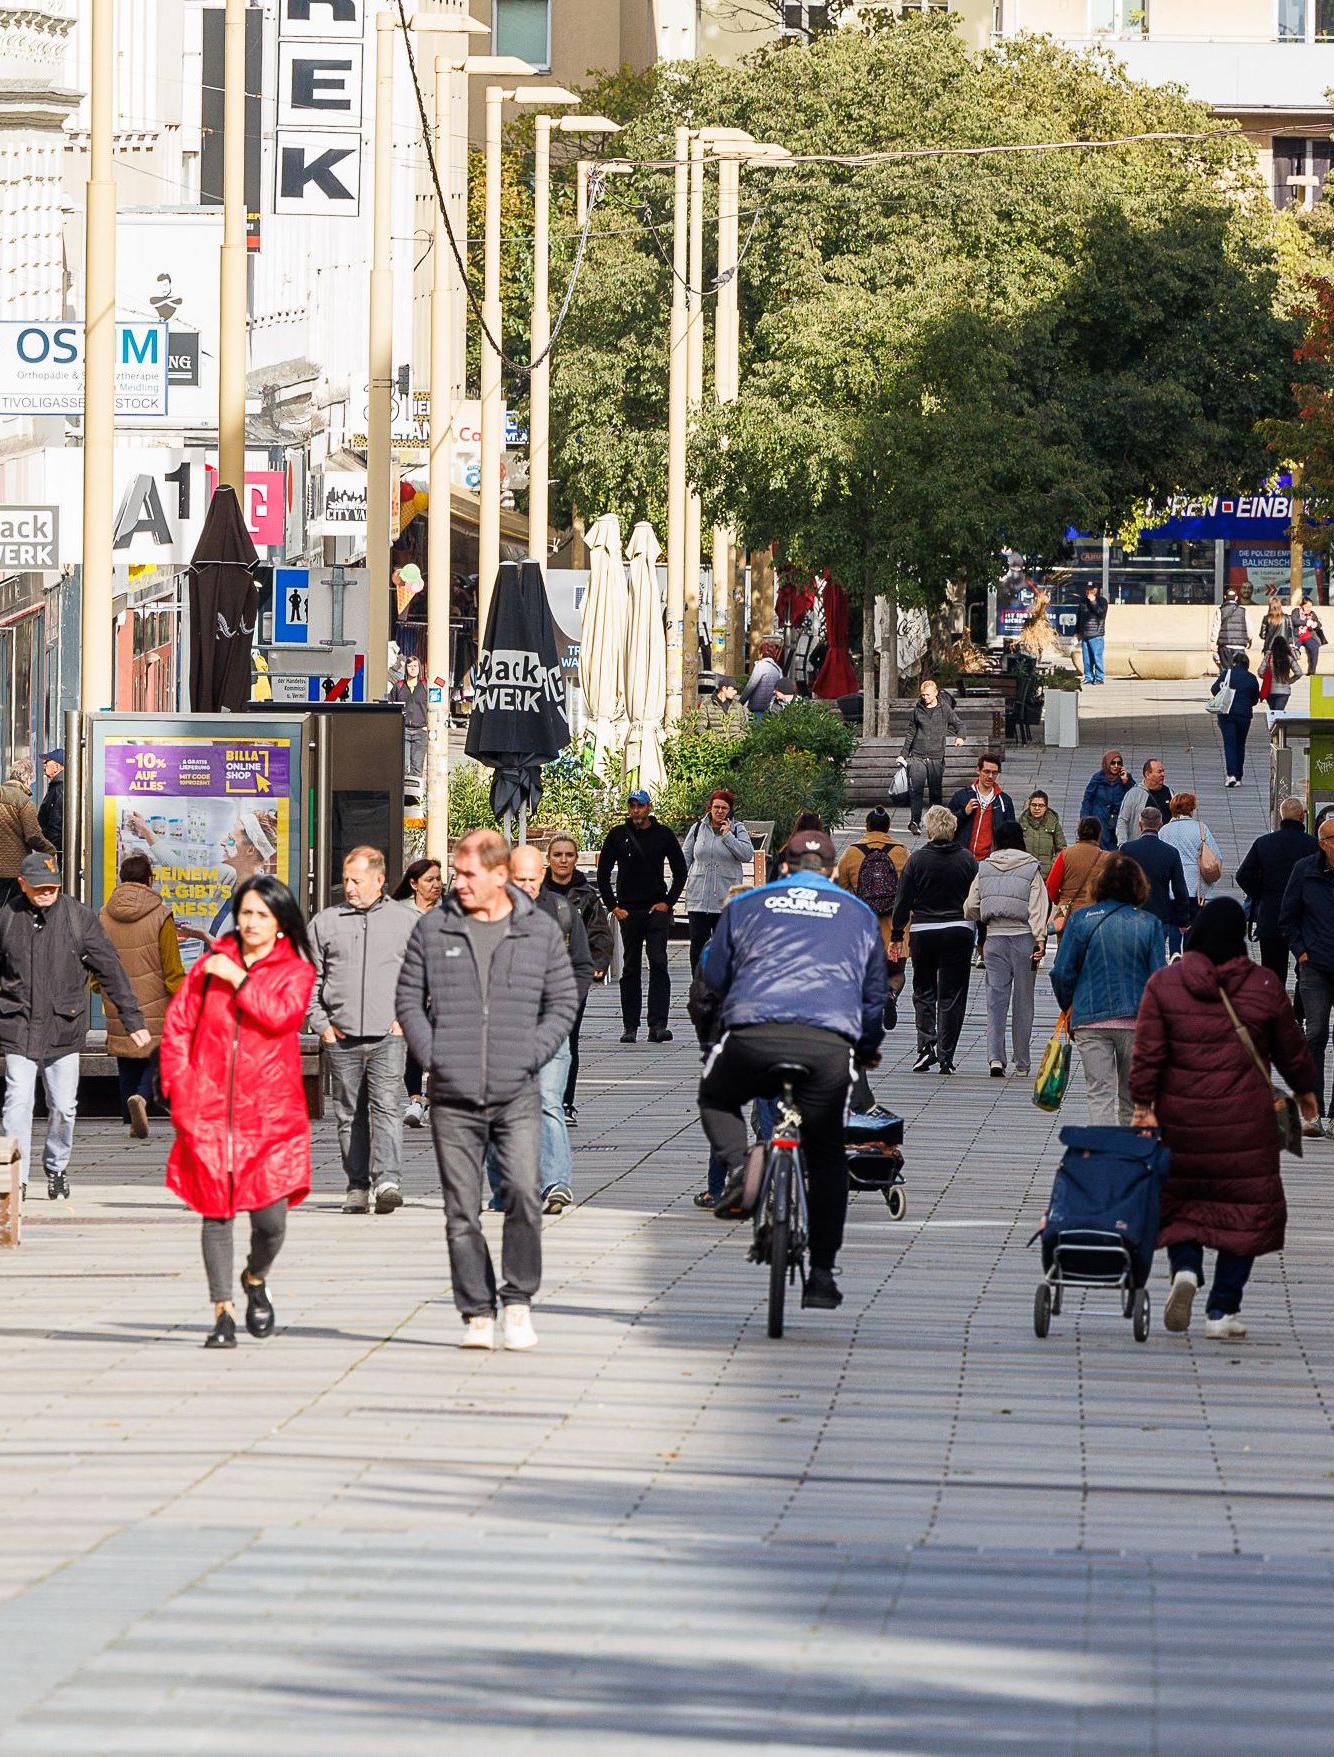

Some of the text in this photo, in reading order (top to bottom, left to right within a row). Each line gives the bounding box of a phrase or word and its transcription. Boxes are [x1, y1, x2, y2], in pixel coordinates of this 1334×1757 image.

[17, 328, 158, 364] OSM
[168, 355, 192, 370] NG
[1236, 496, 1293, 518] EINB
[567, 645, 581, 656] TR
[561, 658, 579, 668] WA
[126, 752, 167, 769] -10%
[225, 750, 259, 762] BILLA
[225, 762, 262, 771] ONLINE
[134, 771, 157, 781] AUF
[225, 771, 251, 780] SHOP
[171, 902, 219, 917] NESS
[764, 896, 841, 914] GOURMET
